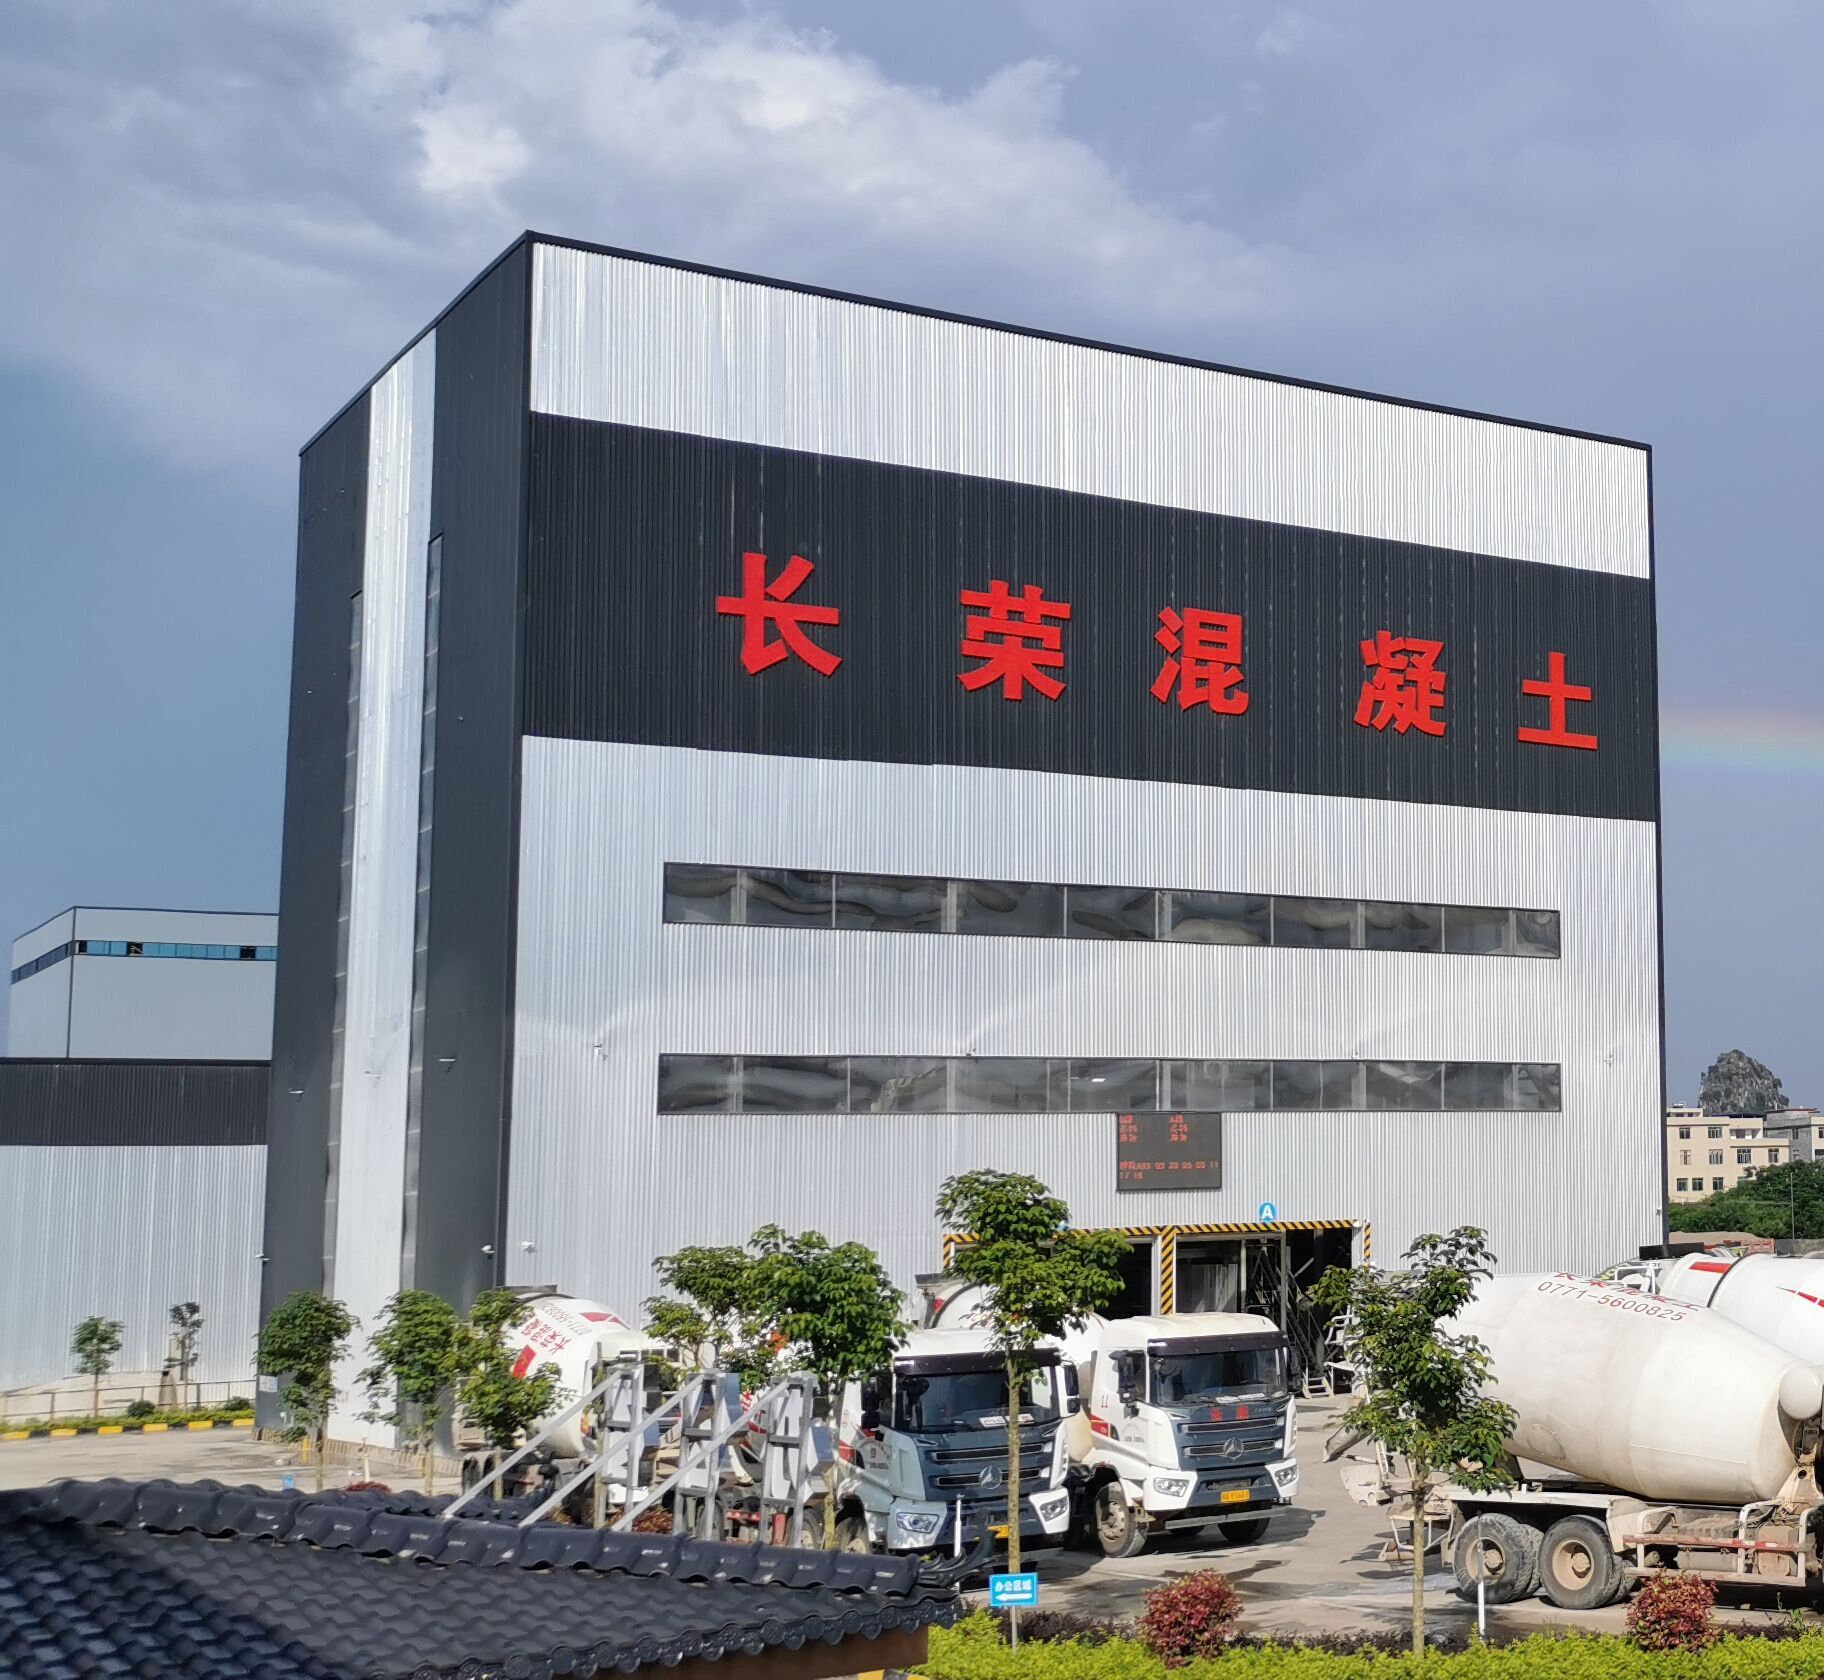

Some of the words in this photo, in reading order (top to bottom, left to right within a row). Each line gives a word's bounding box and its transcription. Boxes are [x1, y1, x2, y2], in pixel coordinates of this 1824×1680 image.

[715, 551, 1598, 750] 长荣混凝土
[1262, 1204, 1273, 1219] A
[1537, 1281, 1687, 1321] 0771-5600825
[994, 1579, 1032, 1592] 办公区域
